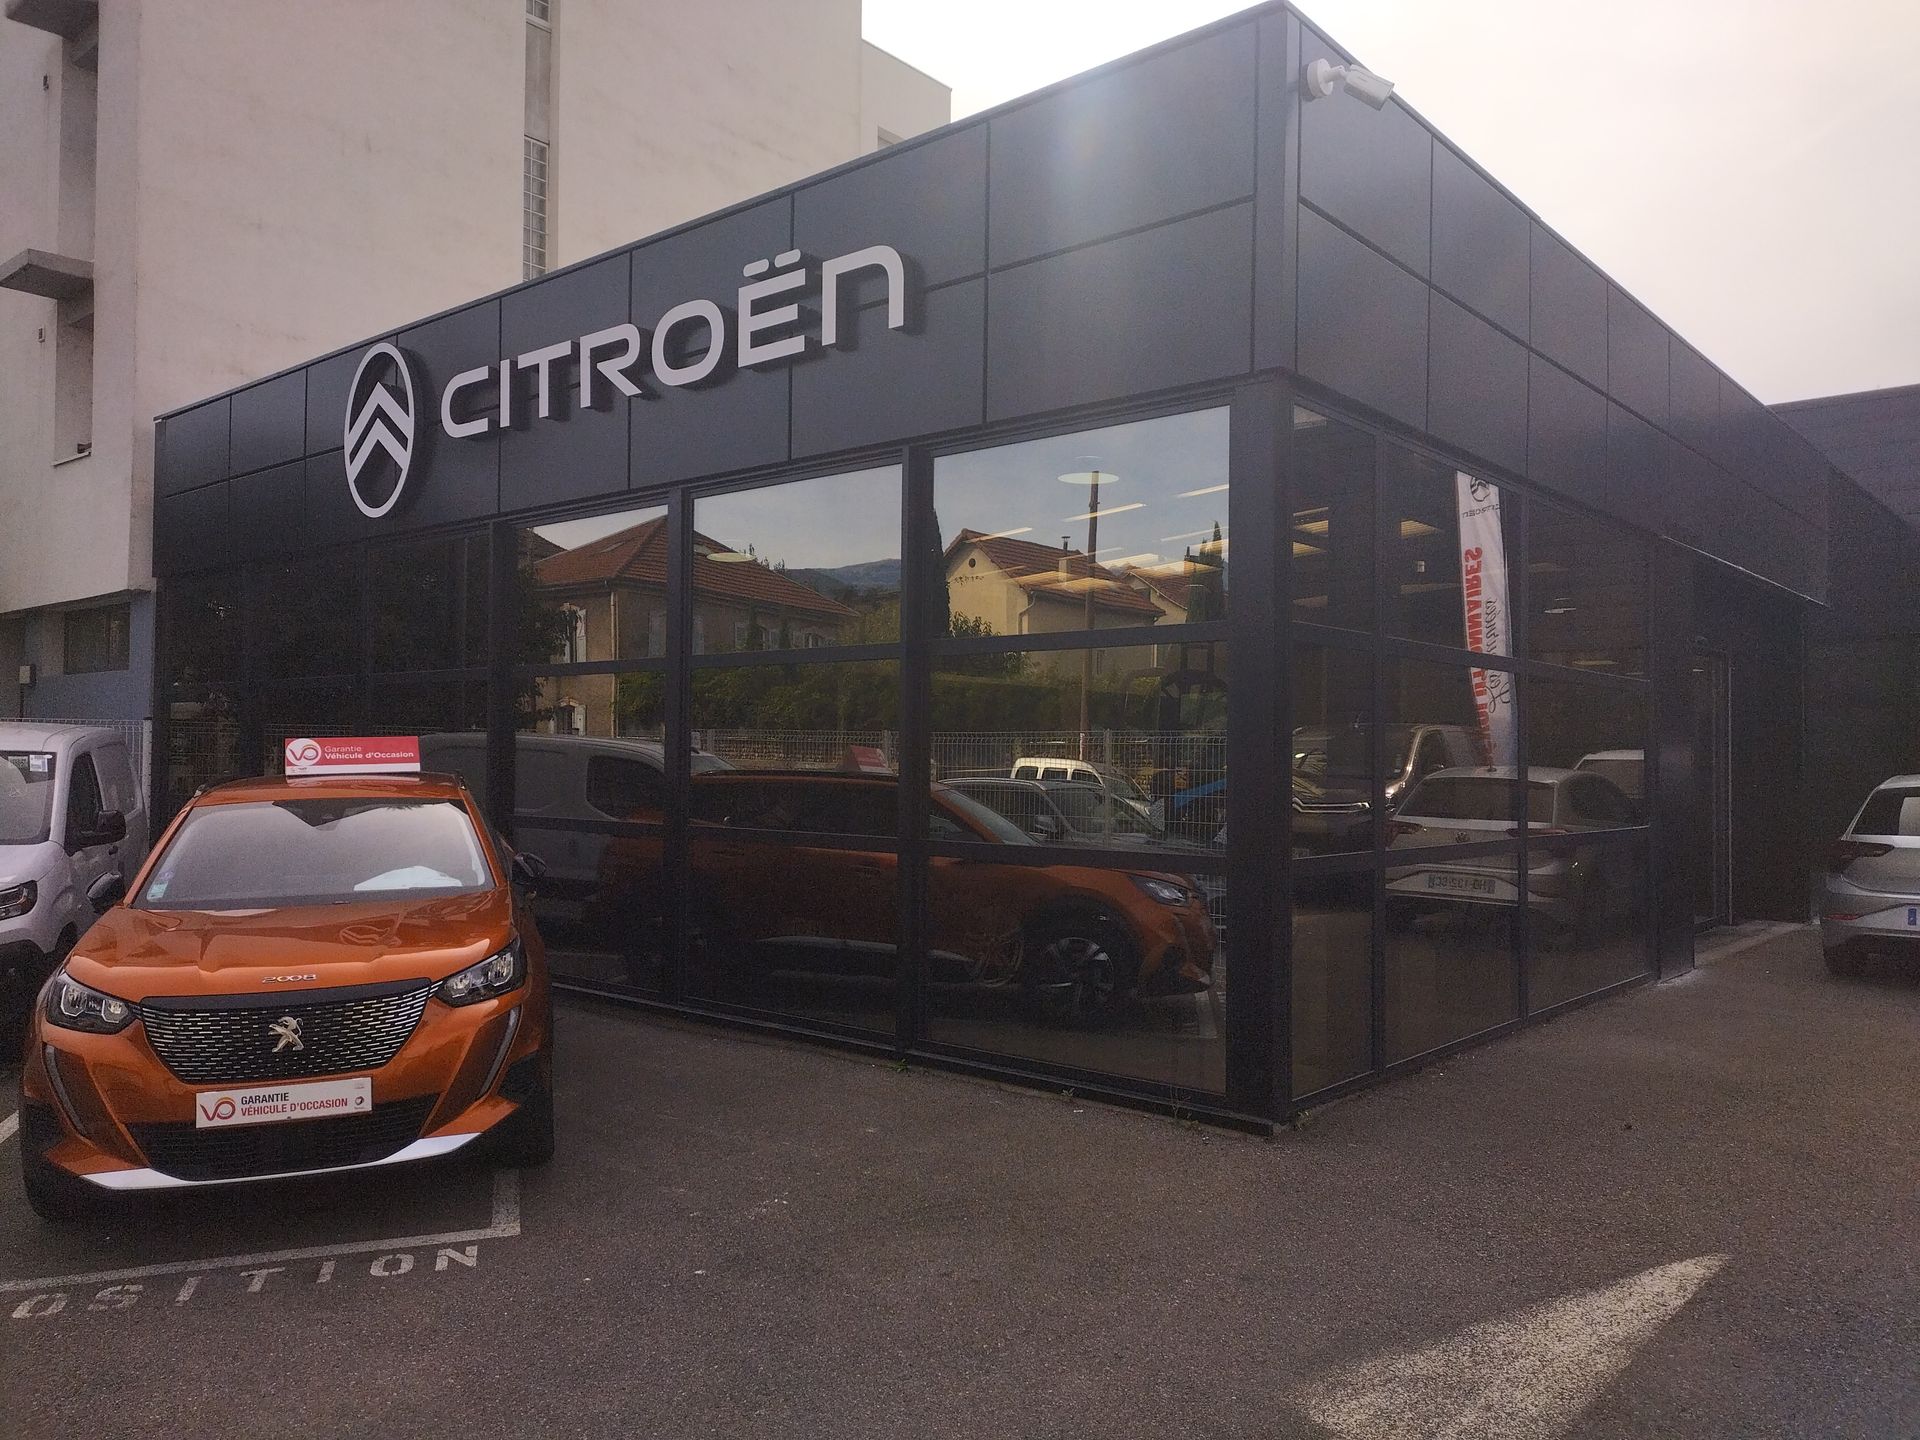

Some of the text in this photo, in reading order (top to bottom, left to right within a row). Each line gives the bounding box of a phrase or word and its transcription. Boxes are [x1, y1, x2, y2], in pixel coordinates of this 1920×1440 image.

[324, 751, 414, 760] Véhicule d'Occasion
[262, 974, 317, 983] 2008
[241, 1092, 289, 1106] GARANTIE
[241, 1098, 348, 1117] VÉHICULE D'OCCASION
